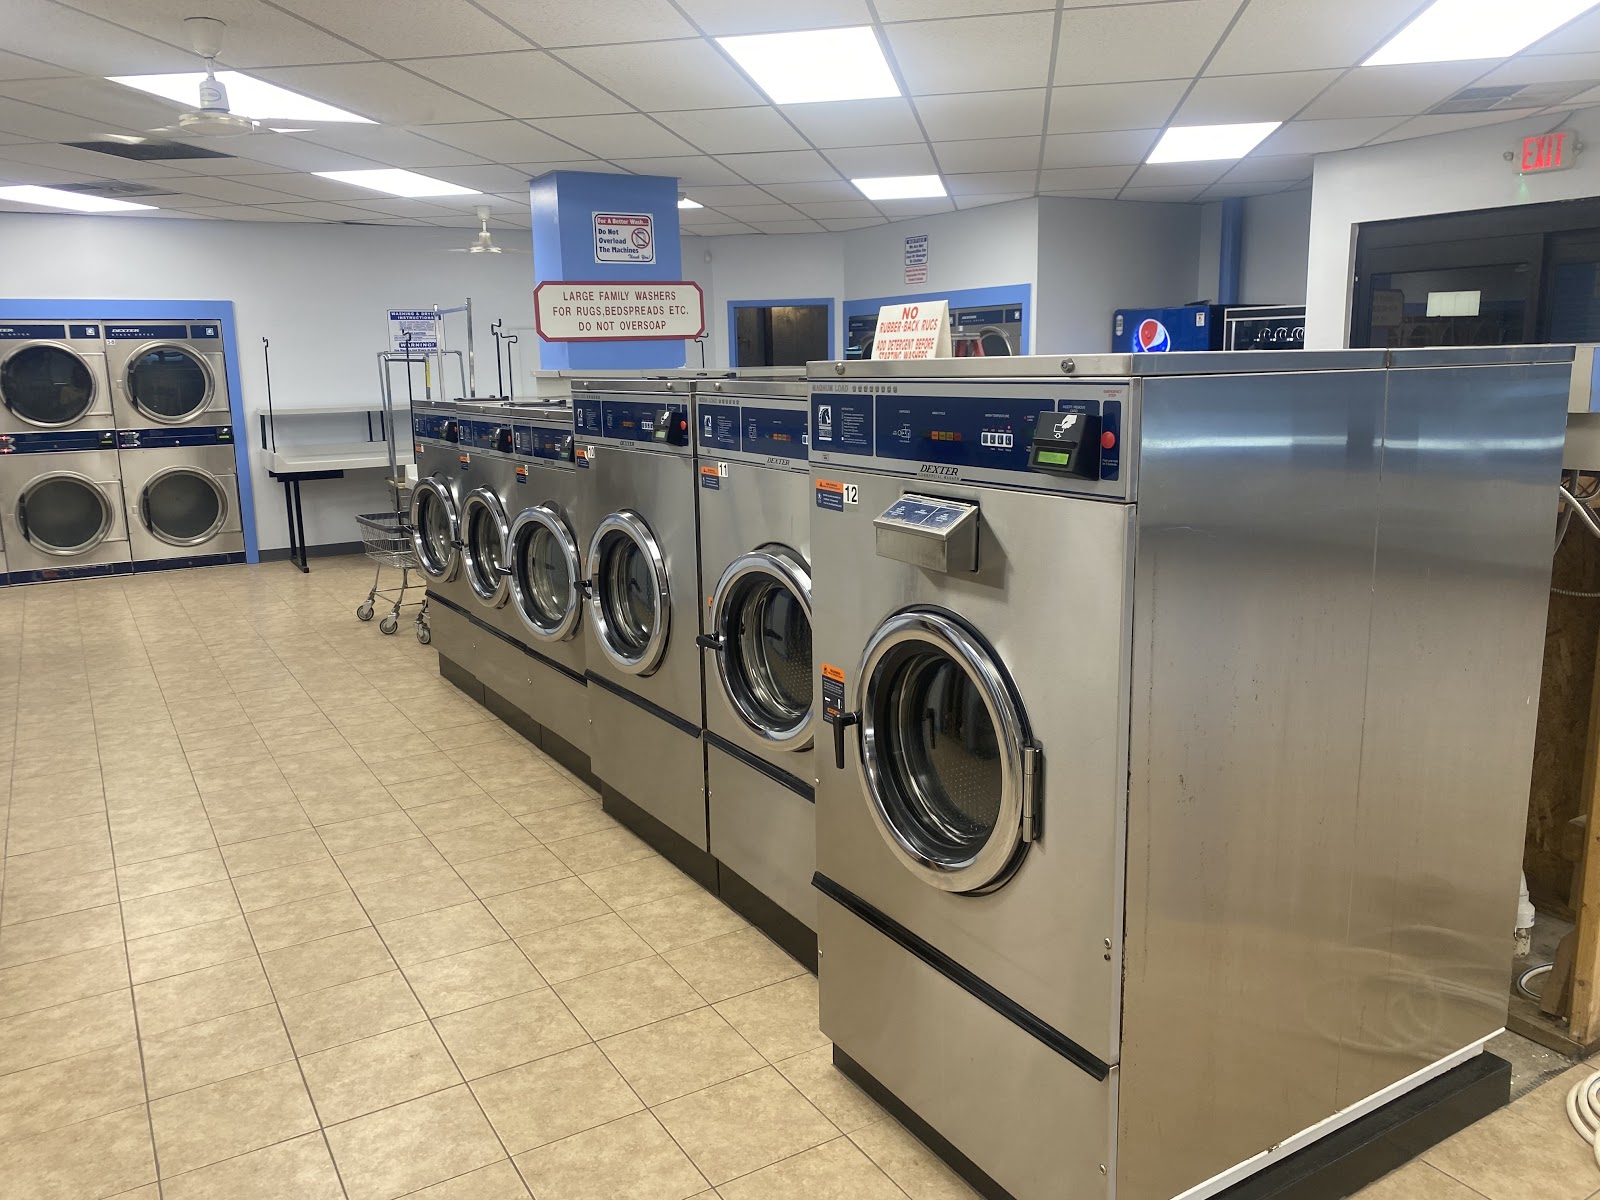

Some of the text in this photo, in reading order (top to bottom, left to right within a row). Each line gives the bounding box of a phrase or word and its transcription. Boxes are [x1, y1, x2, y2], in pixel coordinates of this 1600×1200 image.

[1521, 133, 1567, 171] EXIT
[608, 228, 619, 236] Not
[598, 237, 627, 245] Overload
[612, 246, 639, 254] Machines
[563, 291, 676, 301] LARGE FAMILY WASHERS
[552, 306, 572, 316] FOR
[669, 305, 689, 315] ETC.
[902, 306, 918, 320] NO
[578, 320, 667, 331] DO NOT OVERSOAP
[921, 318, 938, 331] RUGS
[876, 337, 935, 351] ADD DETERGENT BEFORE
[766, 456, 790, 466] DEXTER
[719, 462, 728, 476] 11
[920, 464, 959, 475] DEXTER
[845, 486, 857, 503] 12
